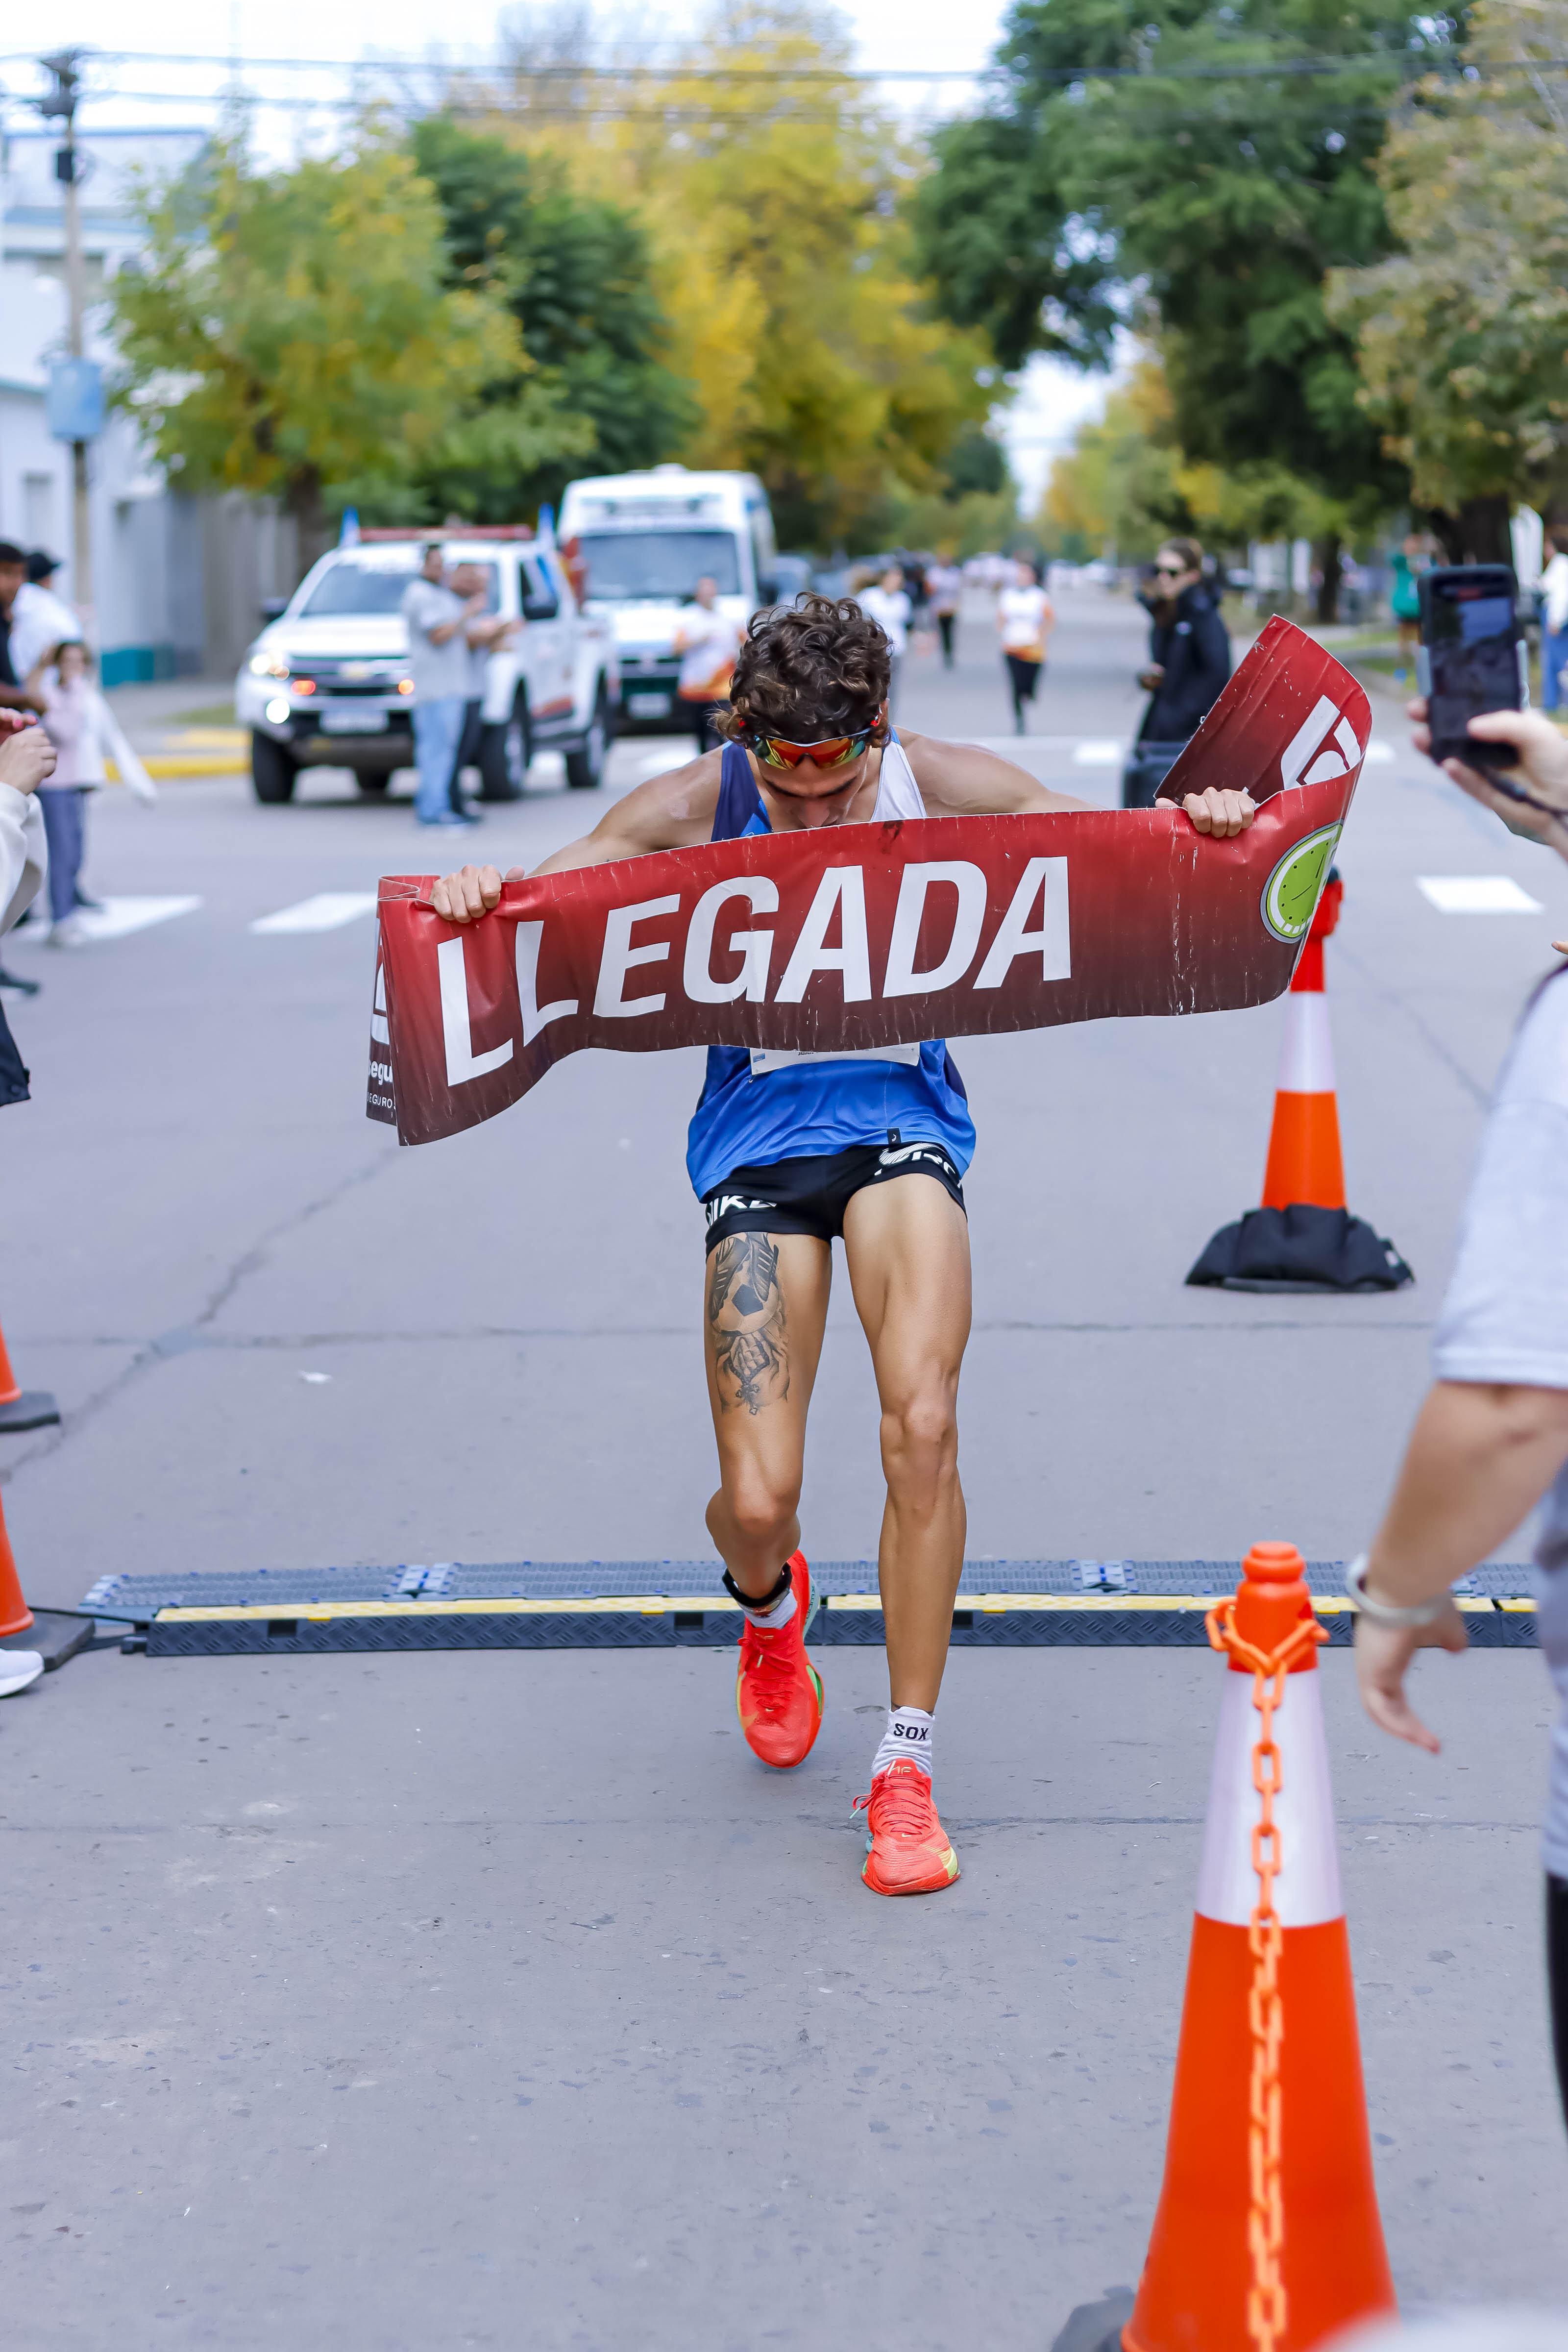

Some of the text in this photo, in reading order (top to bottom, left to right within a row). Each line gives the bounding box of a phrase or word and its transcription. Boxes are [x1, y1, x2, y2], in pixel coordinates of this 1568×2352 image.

[437, 856, 1071, 1087] LLEGADA
[367, 1092, 396, 1110] EGURO
[893, 1723, 929, 1740] SOX
